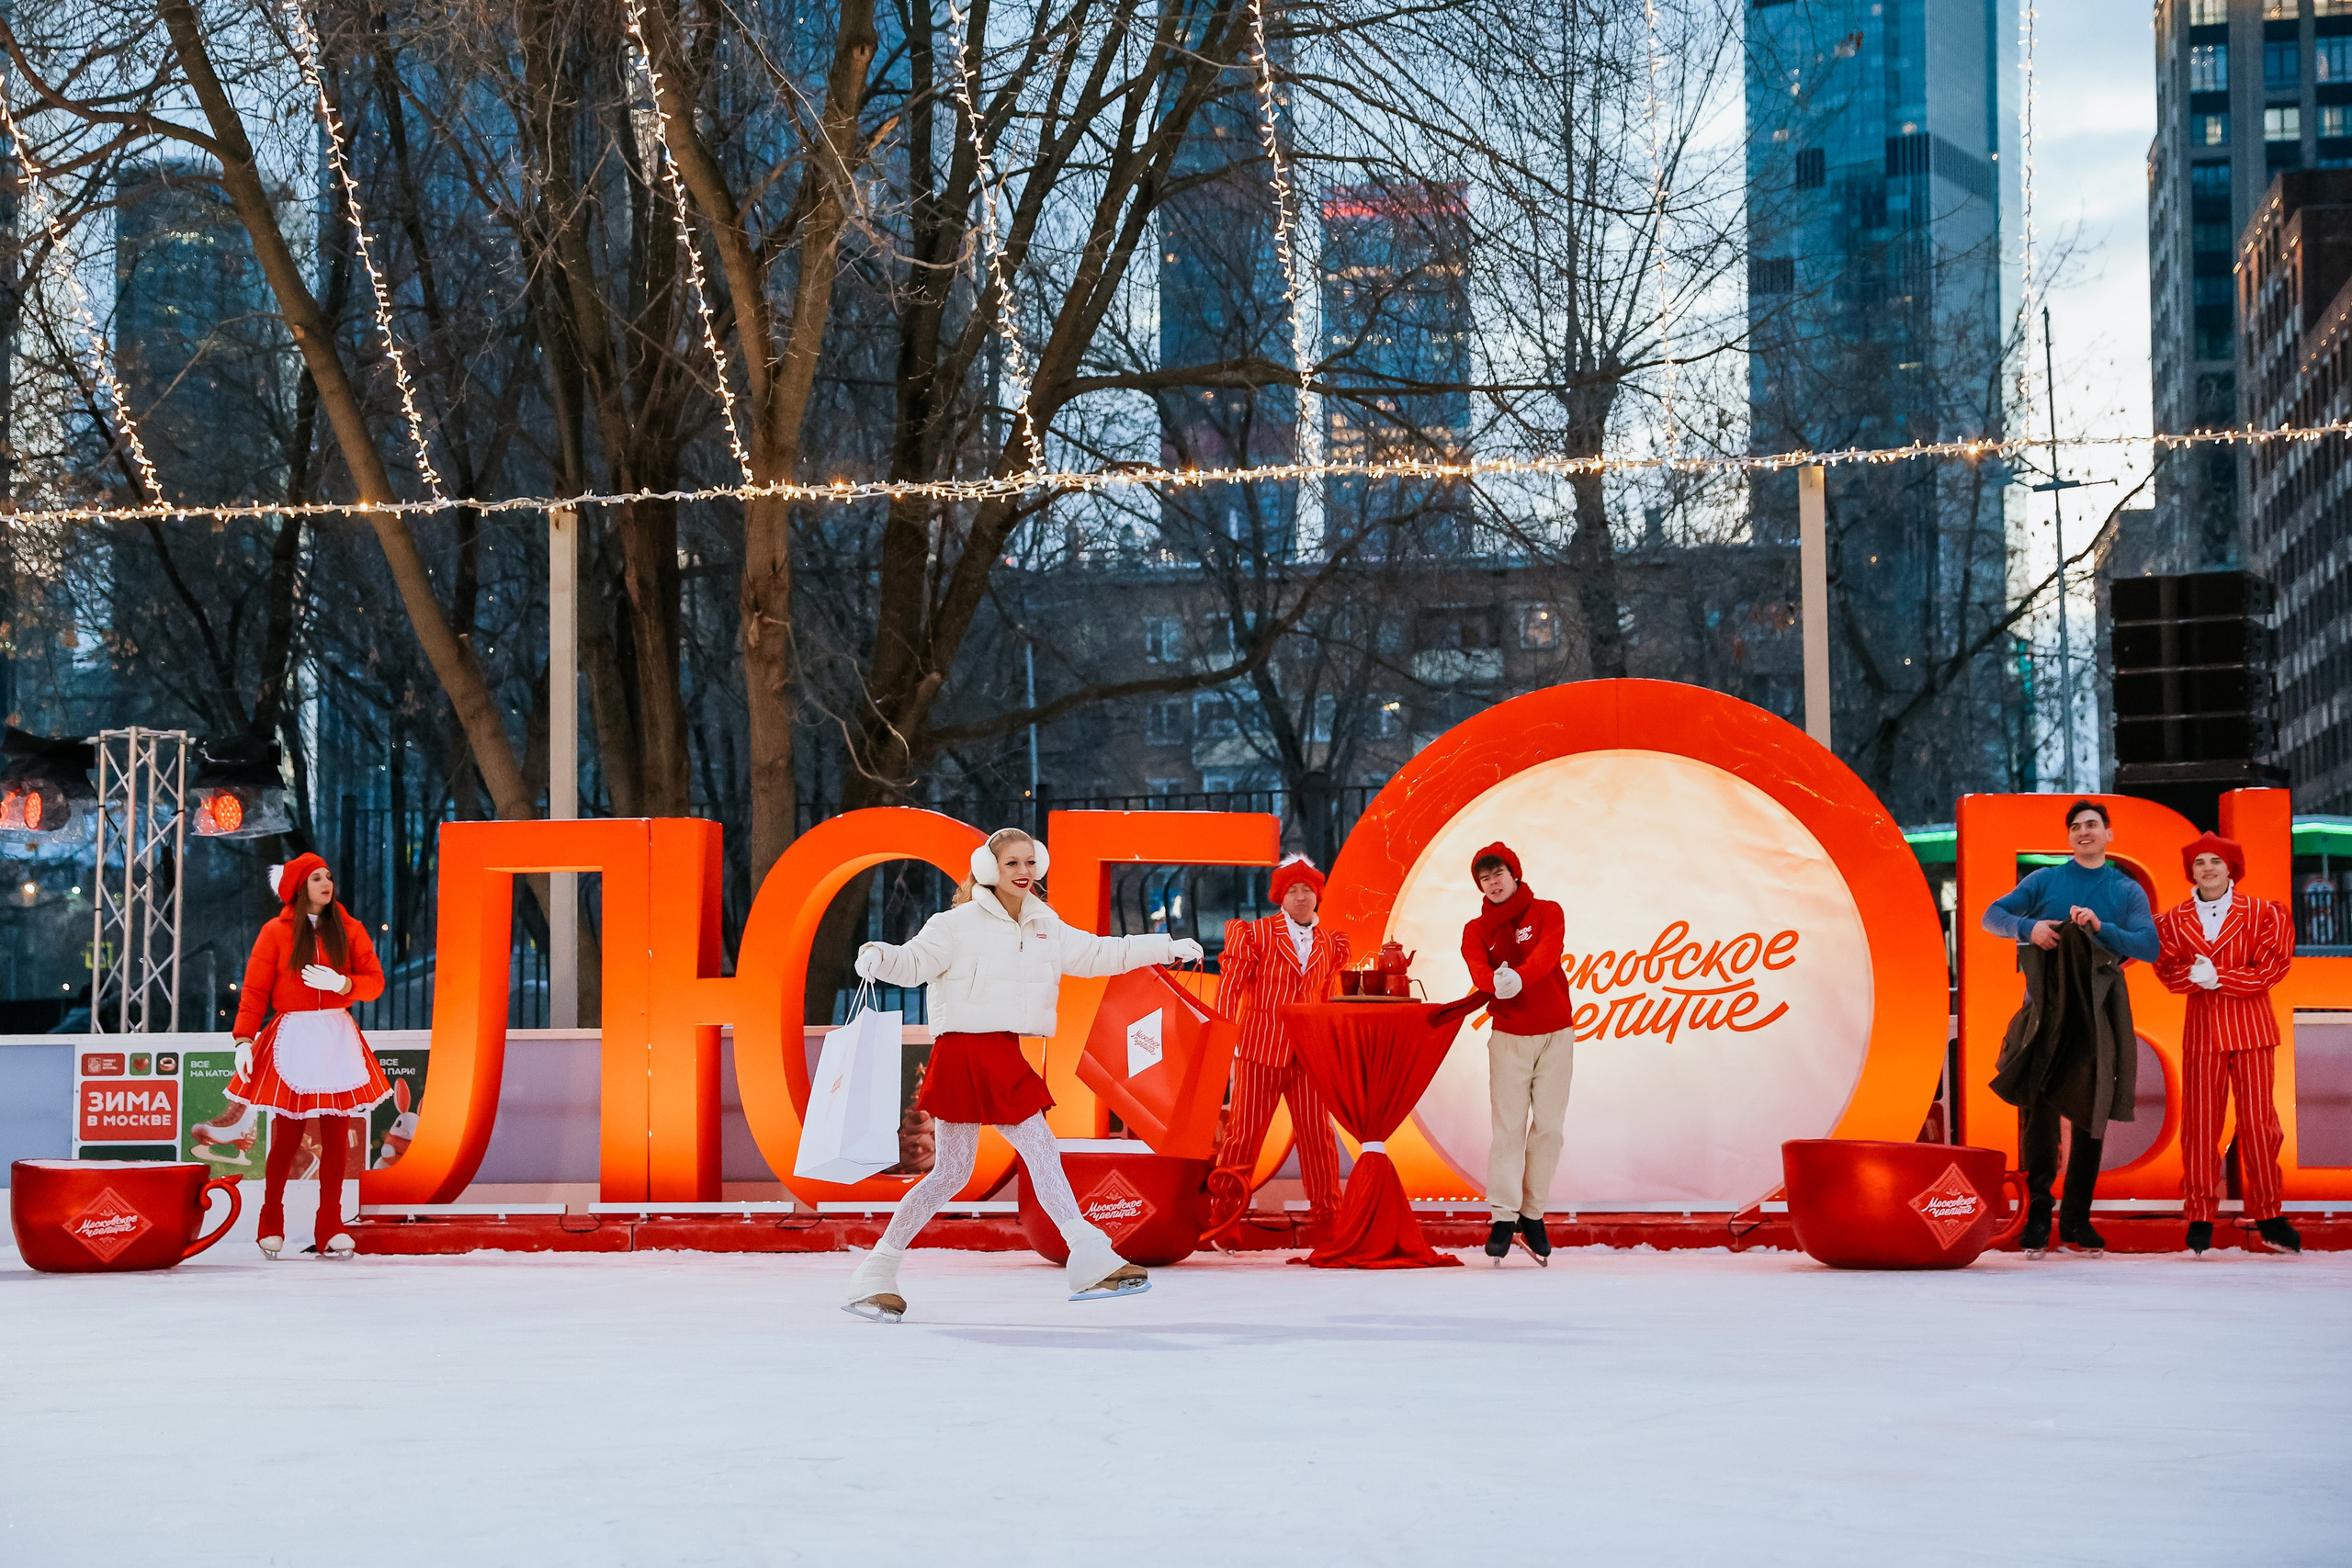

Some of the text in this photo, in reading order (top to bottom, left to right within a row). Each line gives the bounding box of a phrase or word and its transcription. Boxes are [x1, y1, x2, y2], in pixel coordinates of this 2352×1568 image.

[1560, 920, 1799, 995] сковское
[1572, 977, 1790, 1044] епитие
[190, 1060, 210, 1068] ВСЕ
[379, 1058, 399, 1066] ВСЕ
[190, 1069, 205, 1077] НА
[87, 1090, 172, 1112] ЗИМА
[87, 1114, 172, 1127] В МОСКВЕ
[1082, 1198, 1143, 1217] Московское
[1089, 1207, 1141, 1222] чаепитие
